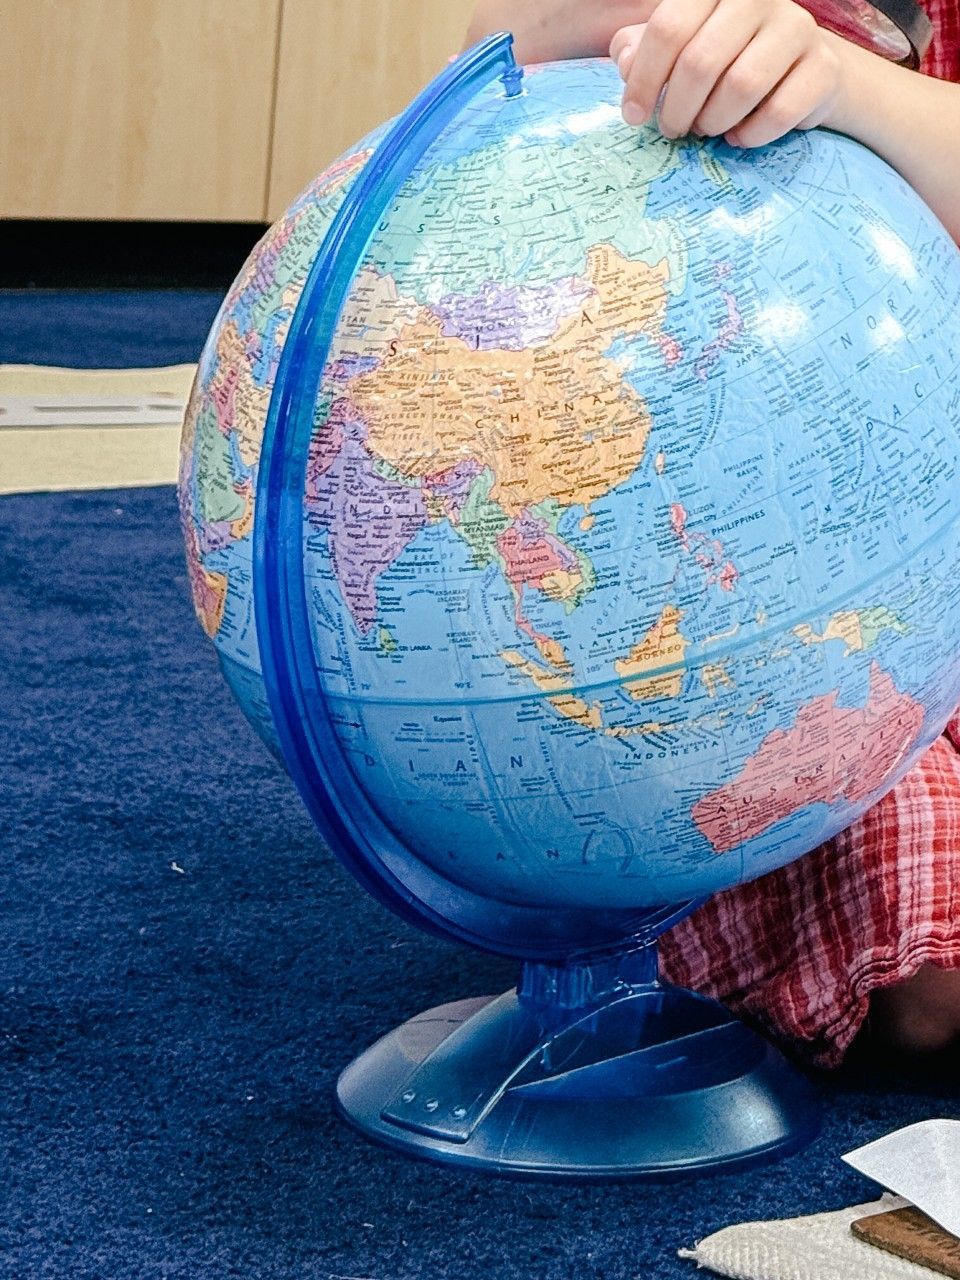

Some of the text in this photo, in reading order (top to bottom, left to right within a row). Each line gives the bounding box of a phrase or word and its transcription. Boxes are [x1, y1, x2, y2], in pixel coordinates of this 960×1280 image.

[736, 344, 764, 368] JAPAN
[475, 394, 602, 429] CHINA
[711, 509, 766, 536] PHILIPPINES
[510, 555, 549, 567] THAILAND
[624, 740, 719, 760] INDONESIA
[716, 718, 903, 813] AUSTRALIA
